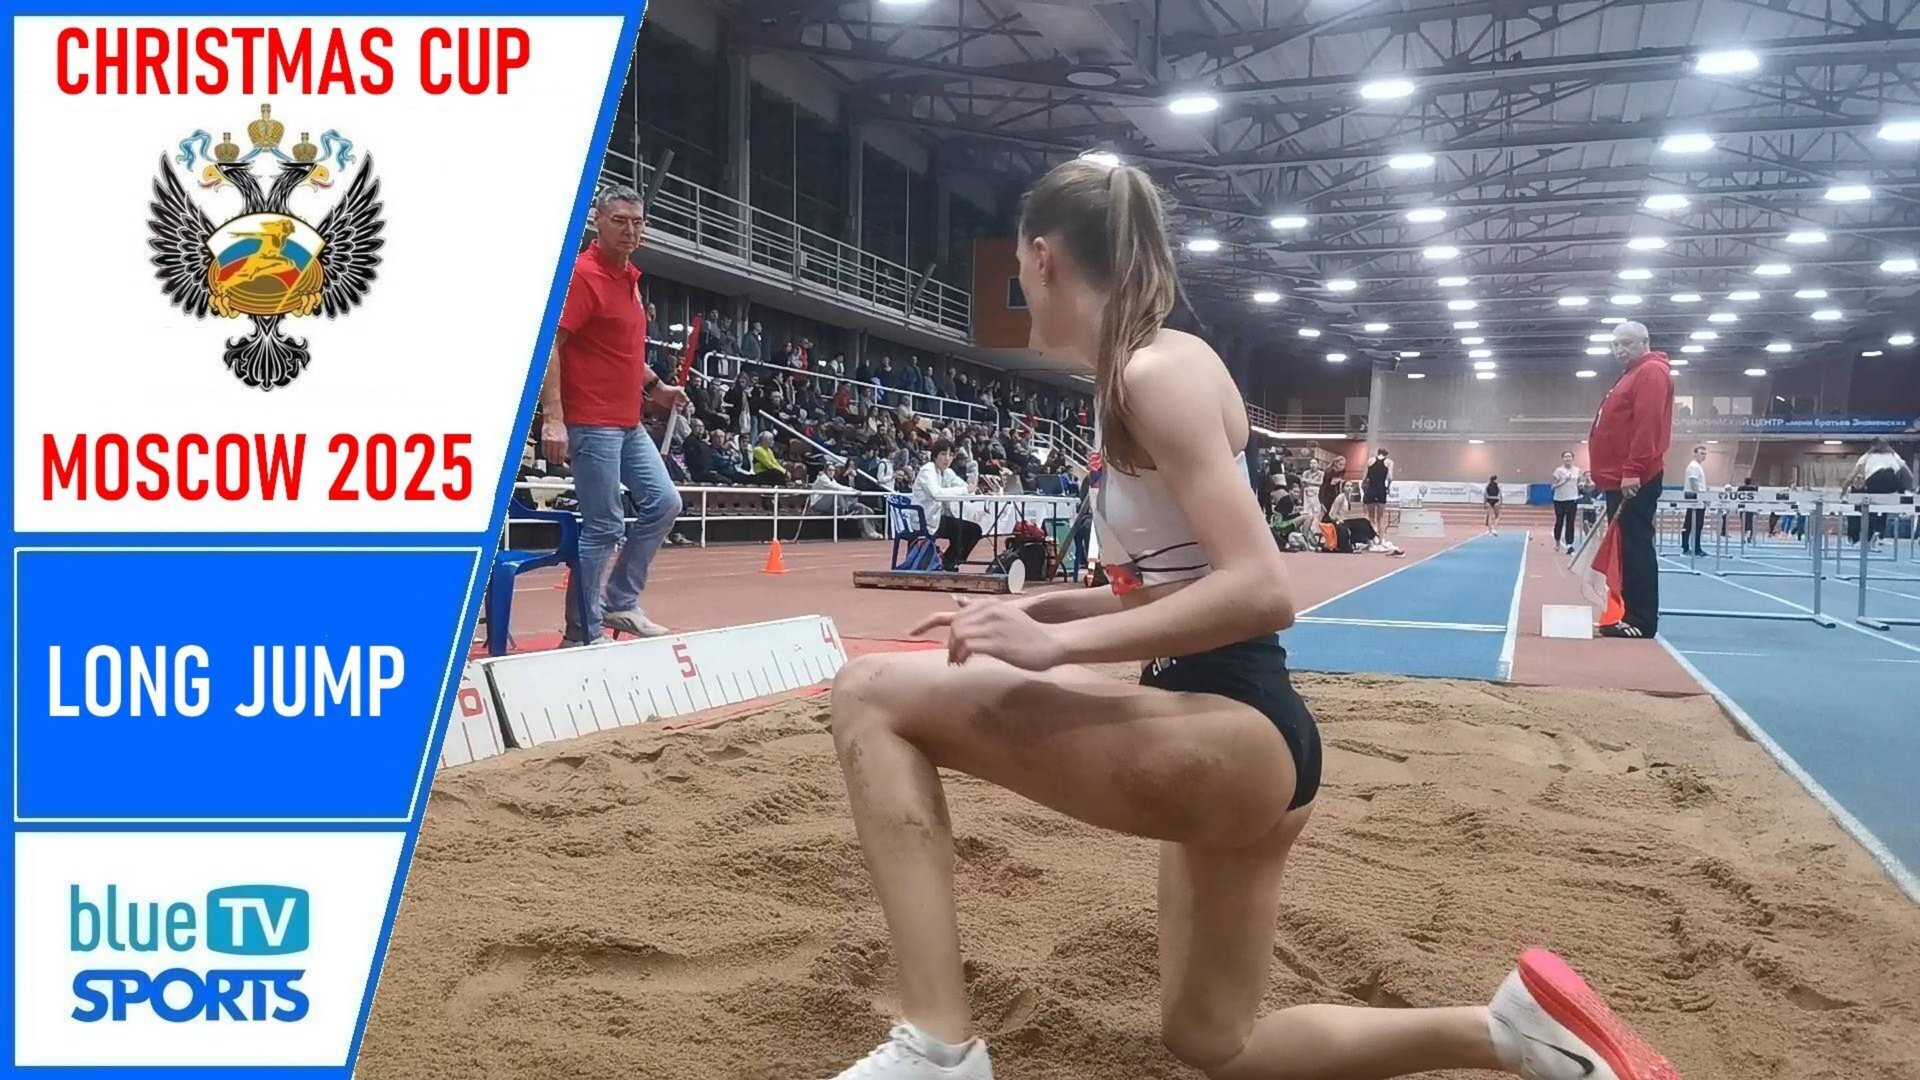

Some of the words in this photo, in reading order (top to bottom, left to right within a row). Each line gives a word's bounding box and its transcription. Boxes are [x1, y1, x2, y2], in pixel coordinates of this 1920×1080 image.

[1751, 418, 1784, 428] ЦЕНТР
[1729, 492, 1755, 501] UCS
[819, 622, 838, 651] 4
[672, 643, 697, 678] 5
